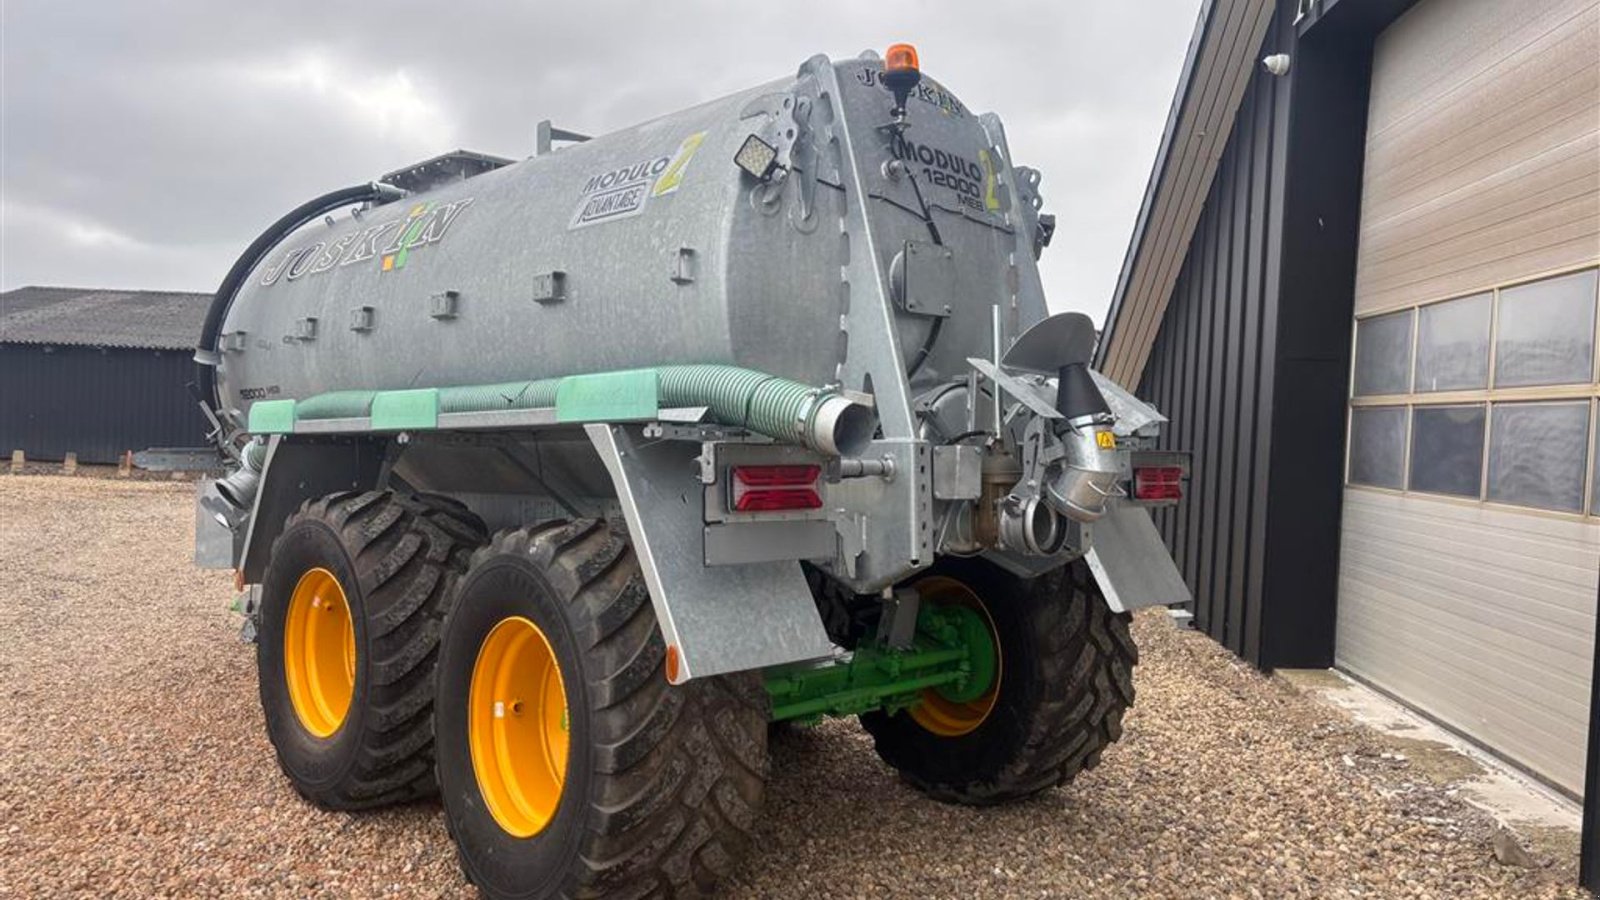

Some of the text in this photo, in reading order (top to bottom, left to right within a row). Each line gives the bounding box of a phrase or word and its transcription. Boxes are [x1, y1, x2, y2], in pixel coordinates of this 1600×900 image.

[582, 156, 670, 194] MODULO
[898, 141, 982, 182] MODULO
[581, 187, 641, 218] ADVANTAGE
[922, 168, 981, 199] 12000
[260, 197, 474, 288] JOSKIN
